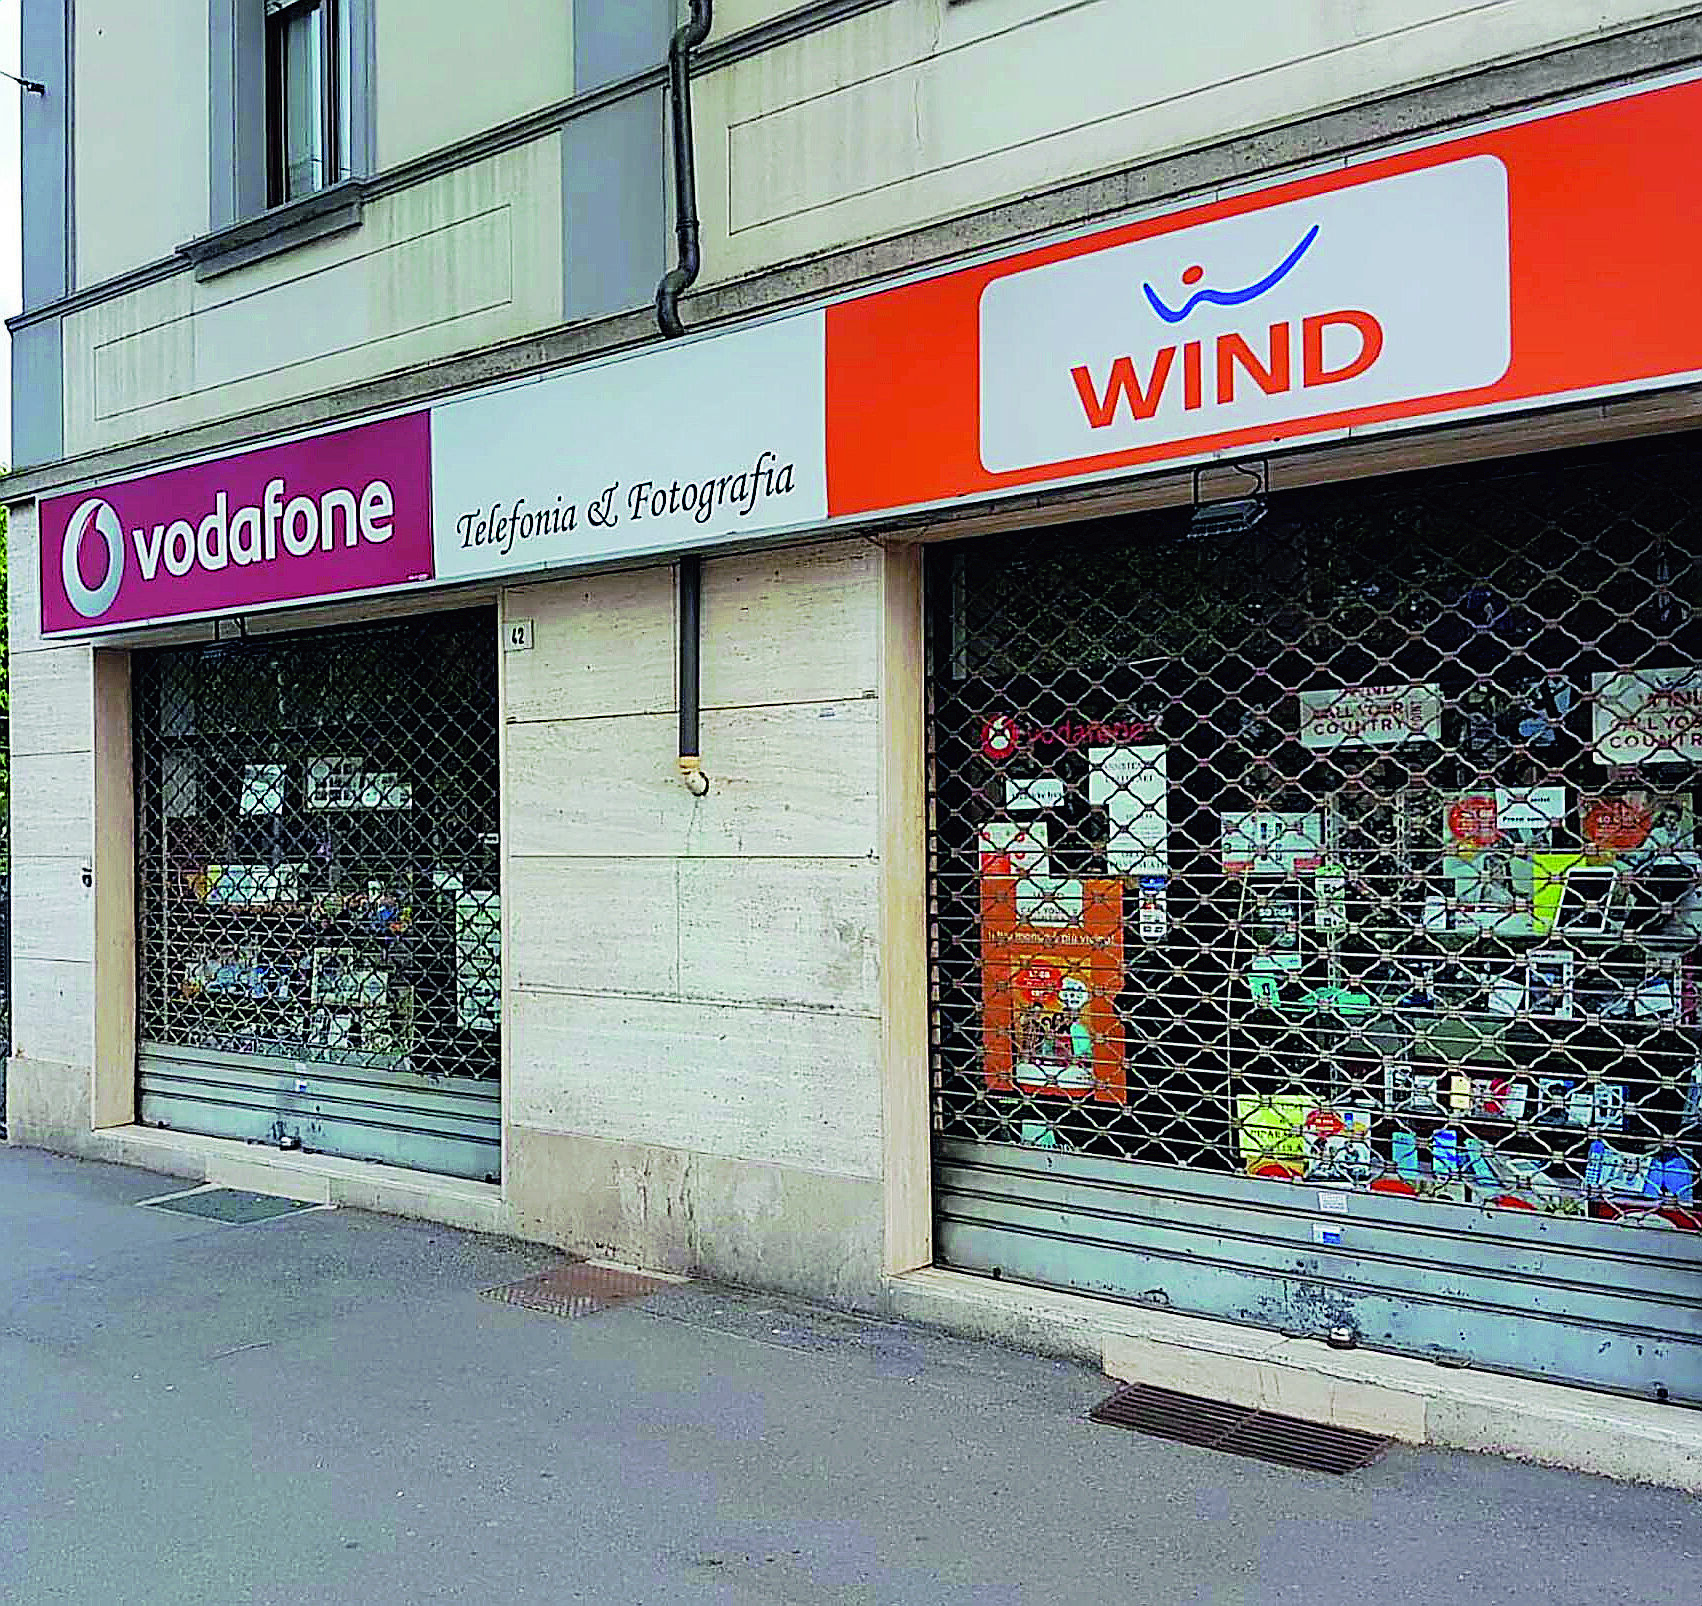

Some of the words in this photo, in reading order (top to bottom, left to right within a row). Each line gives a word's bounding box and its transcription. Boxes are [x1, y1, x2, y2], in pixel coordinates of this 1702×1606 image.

[1069, 309, 1384, 429] WIND
[133, 478, 394, 581] vodafone
[456, 496, 579, 556] Telefonia
[587, 481, 619, 528] &
[627, 450, 796, 524] Fotografia
[511, 627, 525, 645] 42
[1609, 732, 1702, 749] COUTR
